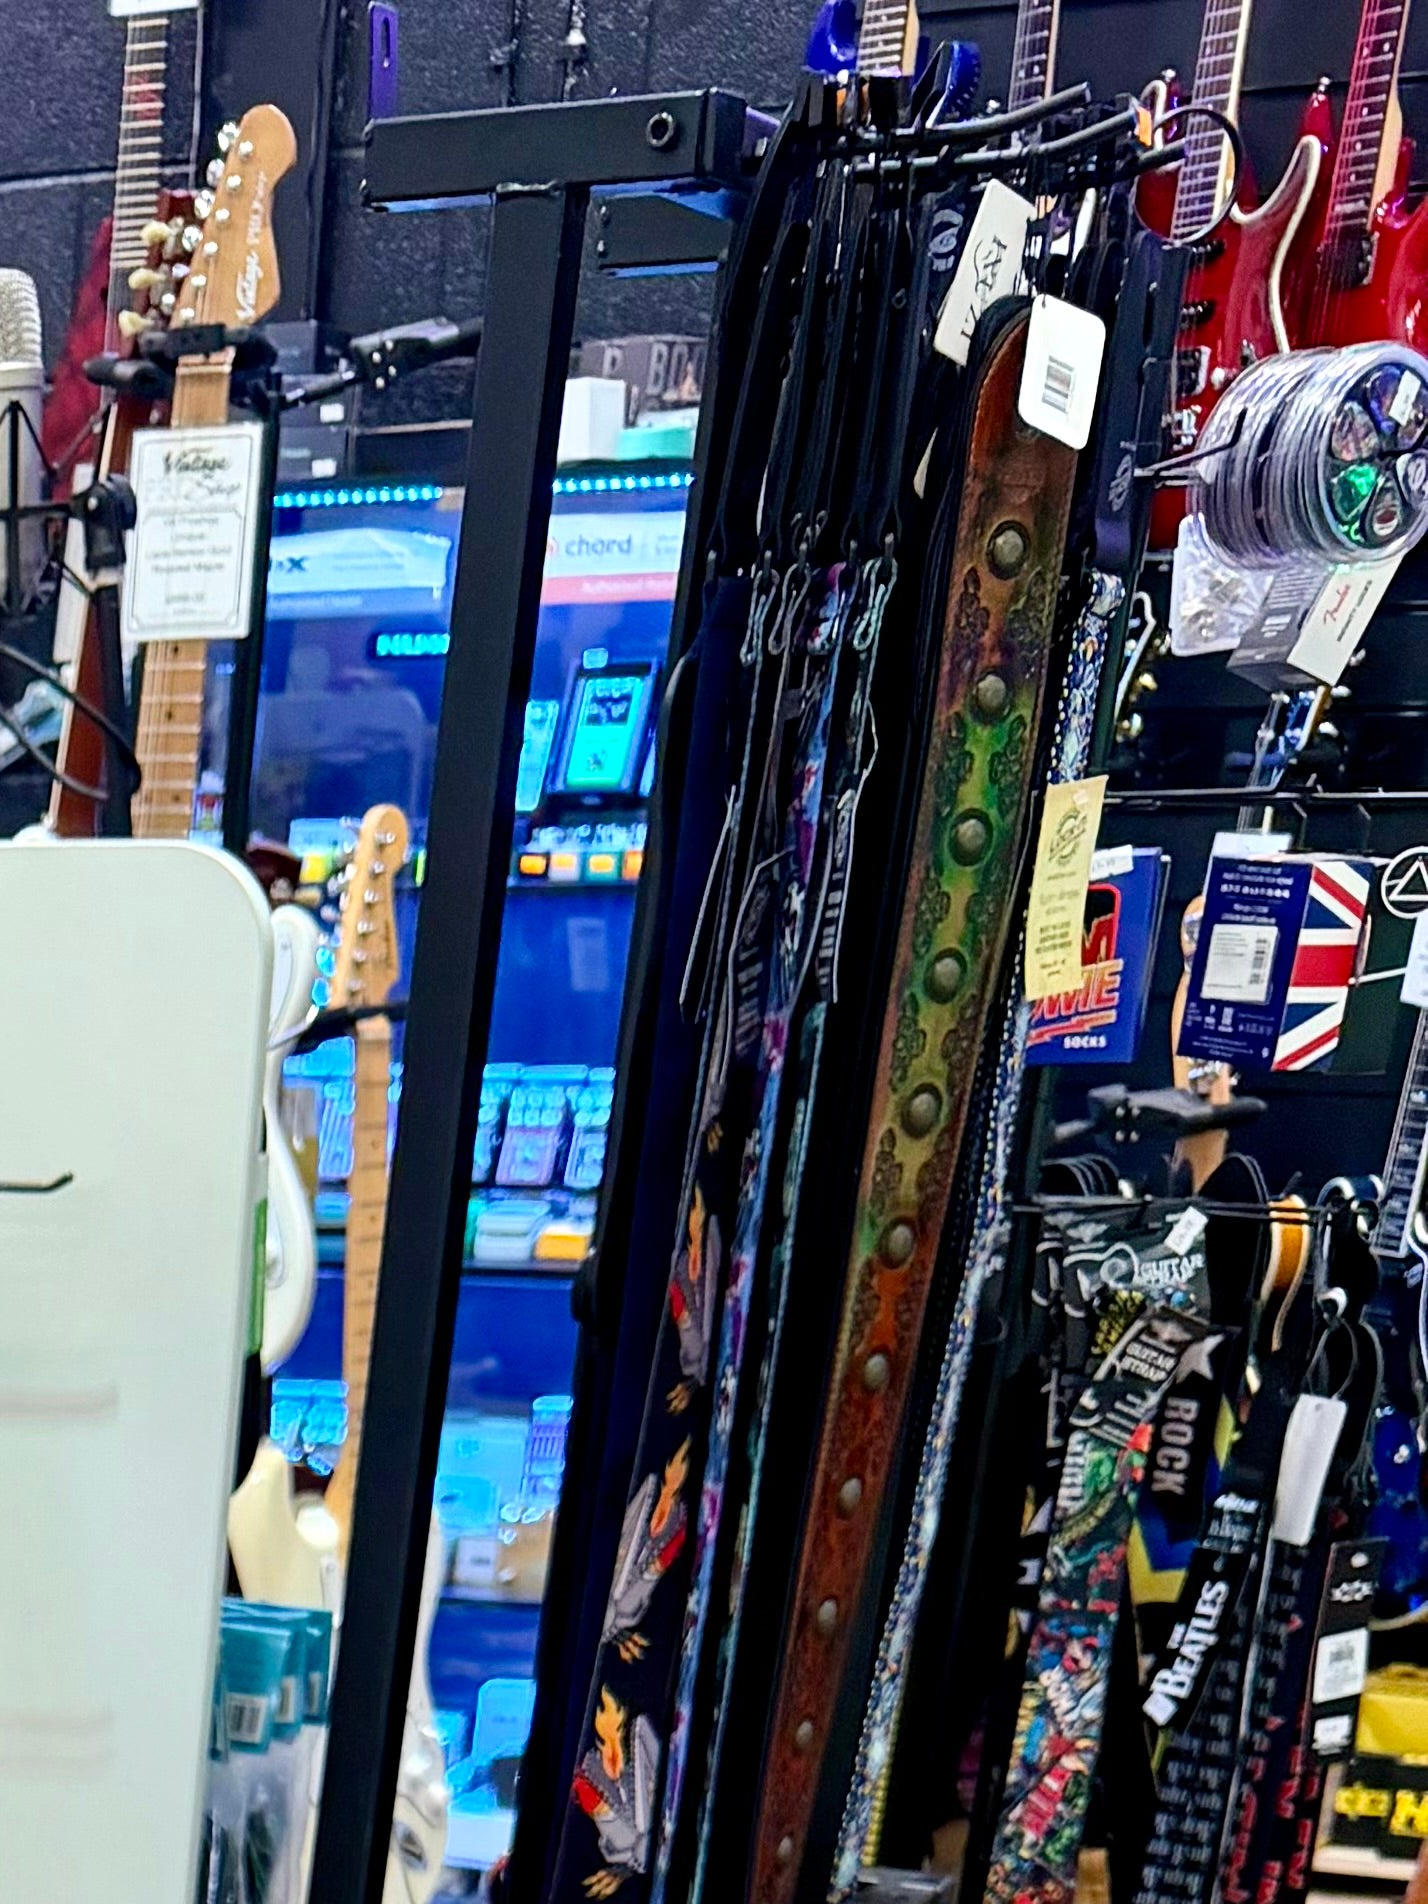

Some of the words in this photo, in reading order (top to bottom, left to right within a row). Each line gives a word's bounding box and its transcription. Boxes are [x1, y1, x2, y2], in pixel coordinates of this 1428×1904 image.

[565, 534, 632, 556] chord
[1063, 1035, 1108, 1050] SOCKS
[1152, 1397, 1200, 1495] ROCK
[1150, 1580, 1229, 1701] BEATLES
